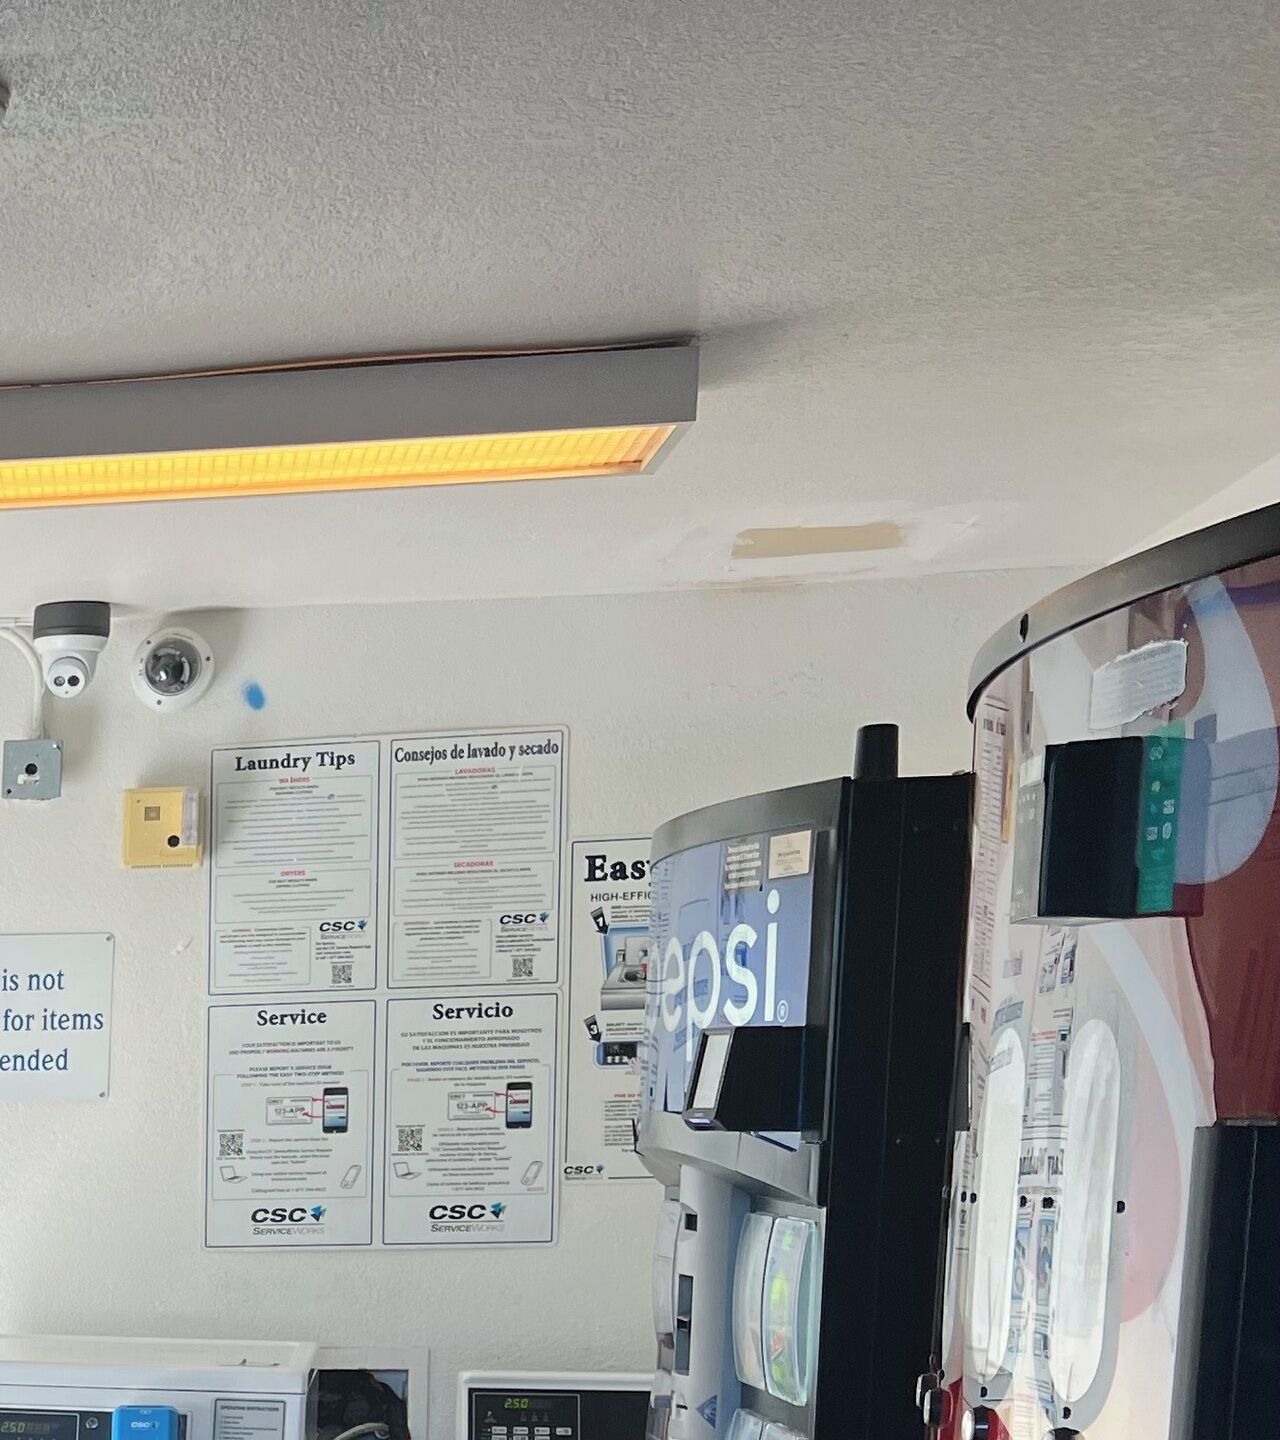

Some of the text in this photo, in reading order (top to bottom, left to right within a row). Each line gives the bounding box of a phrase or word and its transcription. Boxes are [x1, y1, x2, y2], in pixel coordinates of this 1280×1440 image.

[235, 751, 355, 771] Laundry Tips
[395, 740, 559, 765] Consejos de lavado y secado
[319, 921, 356, 932] CSC
[500, 913, 537, 924] CSC
[2, 968, 19, 991] is
[27, 969, 65, 991] not
[3, 1008, 35, 1032] for
[41, 1008, 104, 1031] items
[256, 1009, 327, 1026] Service
[433, 1003, 514, 1020] Servicio
[564, 1166, 594, 1175] CSC
[251, 1208, 308, 1223] CSC
[429, 1204, 486, 1220] CSC
